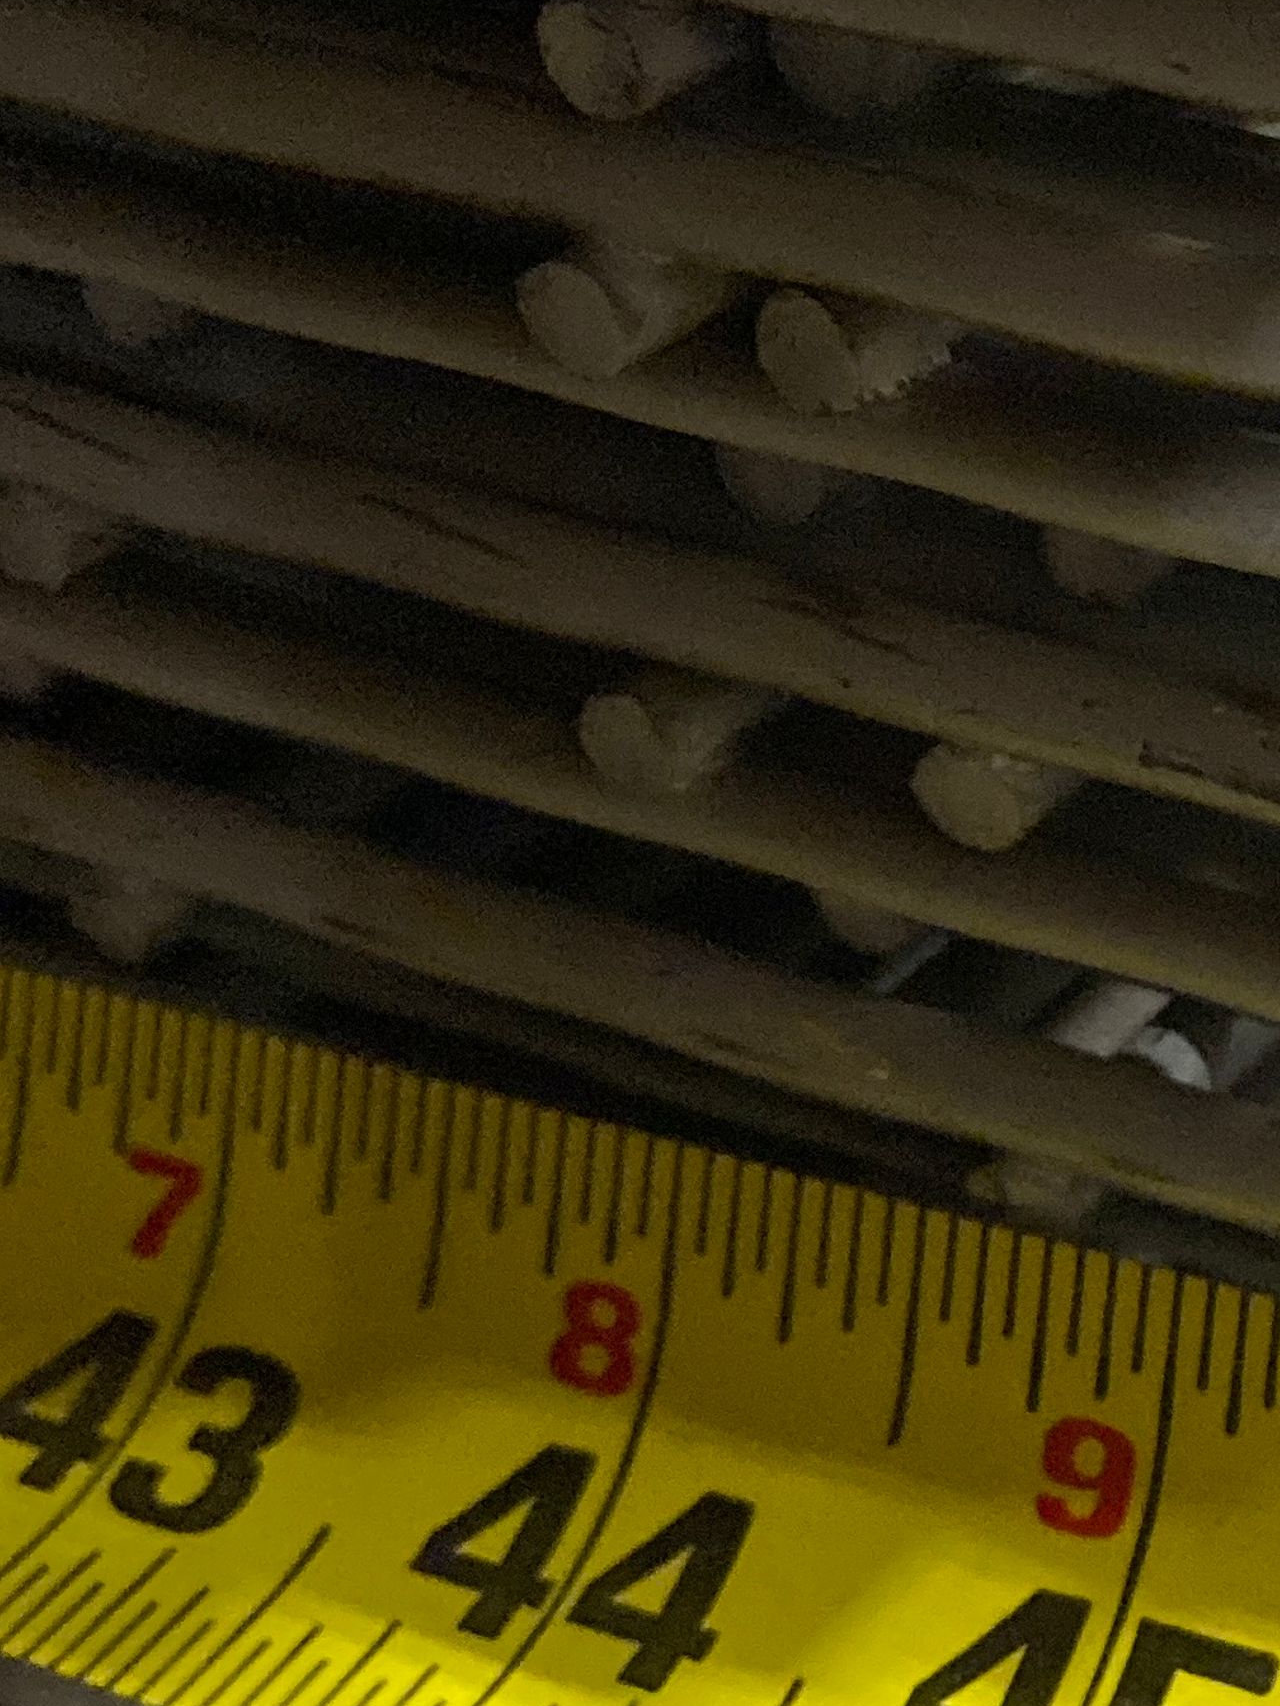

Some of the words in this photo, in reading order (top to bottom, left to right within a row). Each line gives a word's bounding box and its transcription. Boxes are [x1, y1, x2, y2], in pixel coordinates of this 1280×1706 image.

[0, 1307, 303, 1534] 43
[408, 1442, 757, 1692] 44
[122, 1148, 201, 1259] 7
[547, 1280, 643, 1398] 8
[1033, 1414, 1137, 1539] 9
